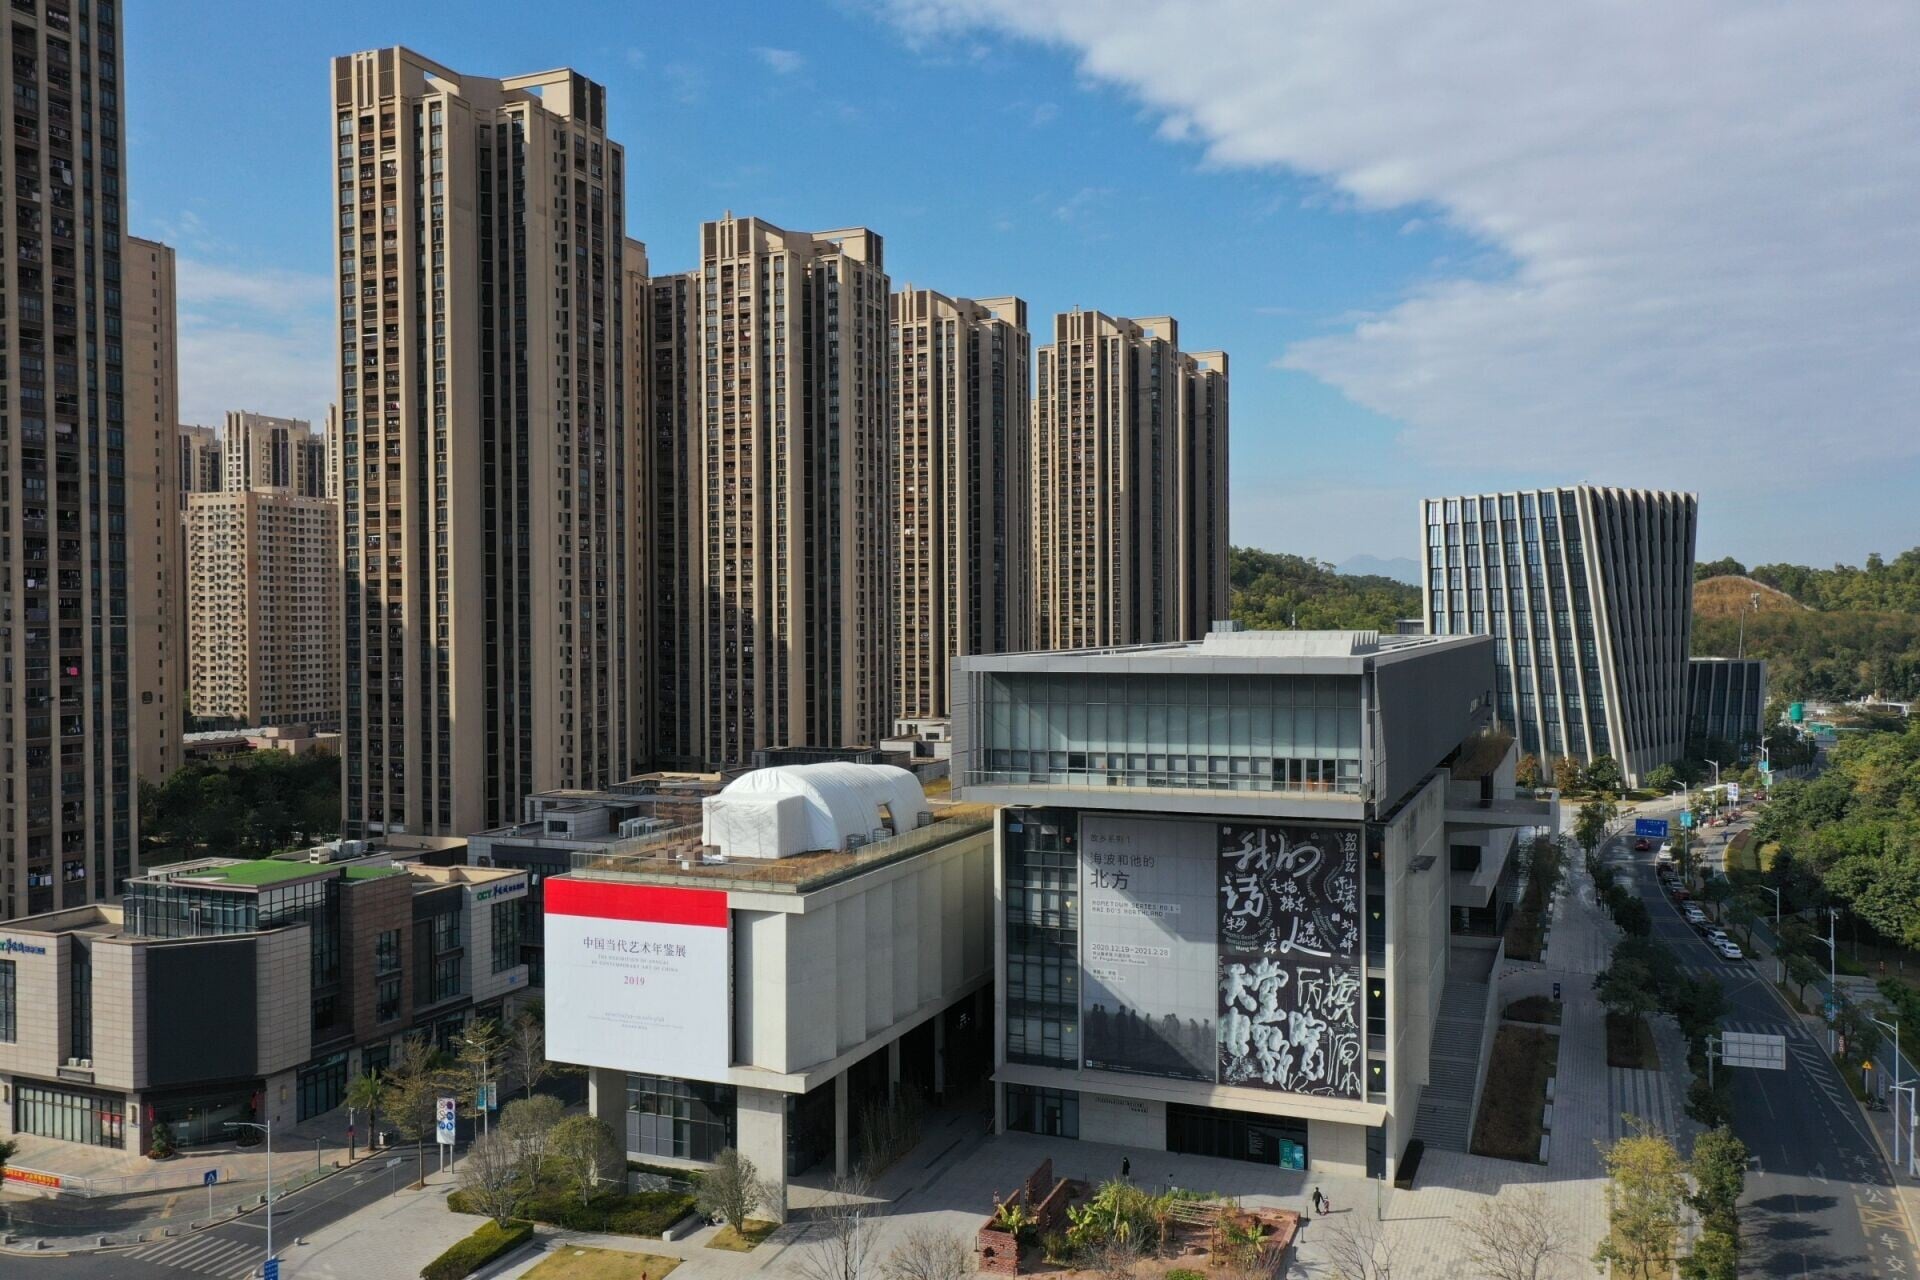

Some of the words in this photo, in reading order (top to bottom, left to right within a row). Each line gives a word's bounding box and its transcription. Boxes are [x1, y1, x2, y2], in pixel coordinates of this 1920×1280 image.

[1090, 851, 1155, 868] 海波和他的
[1090, 868, 1130, 890] 北方
[1132, 902, 1157, 910] SERIES
[583, 936, 687, 958] 中国当代艺术年鉴展
[623, 975, 645, 985] 2019
